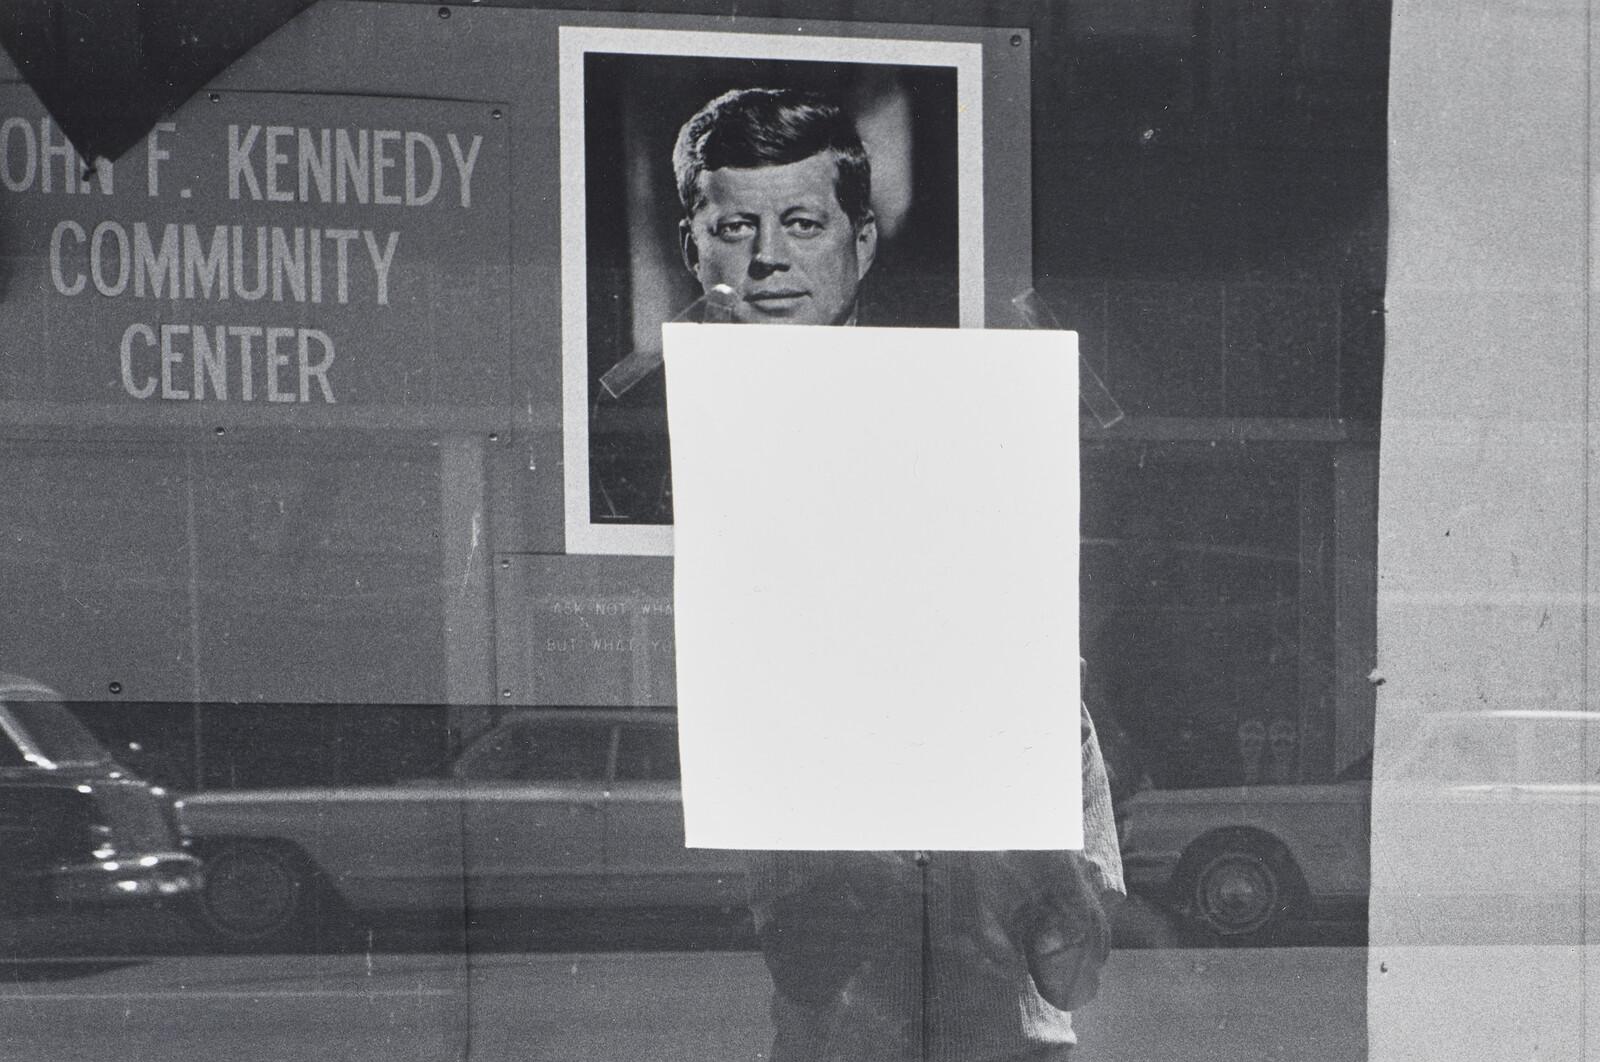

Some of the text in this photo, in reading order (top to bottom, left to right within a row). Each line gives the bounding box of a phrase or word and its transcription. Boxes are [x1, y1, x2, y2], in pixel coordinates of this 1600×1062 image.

[228, 124, 483, 208] KENNEDY
[49, 219, 400, 305] COMMUNITY
[120, 322, 336, 404] CENTER
[595, 603, 627, 616] NOT
[641, 604, 673, 616] WHA
